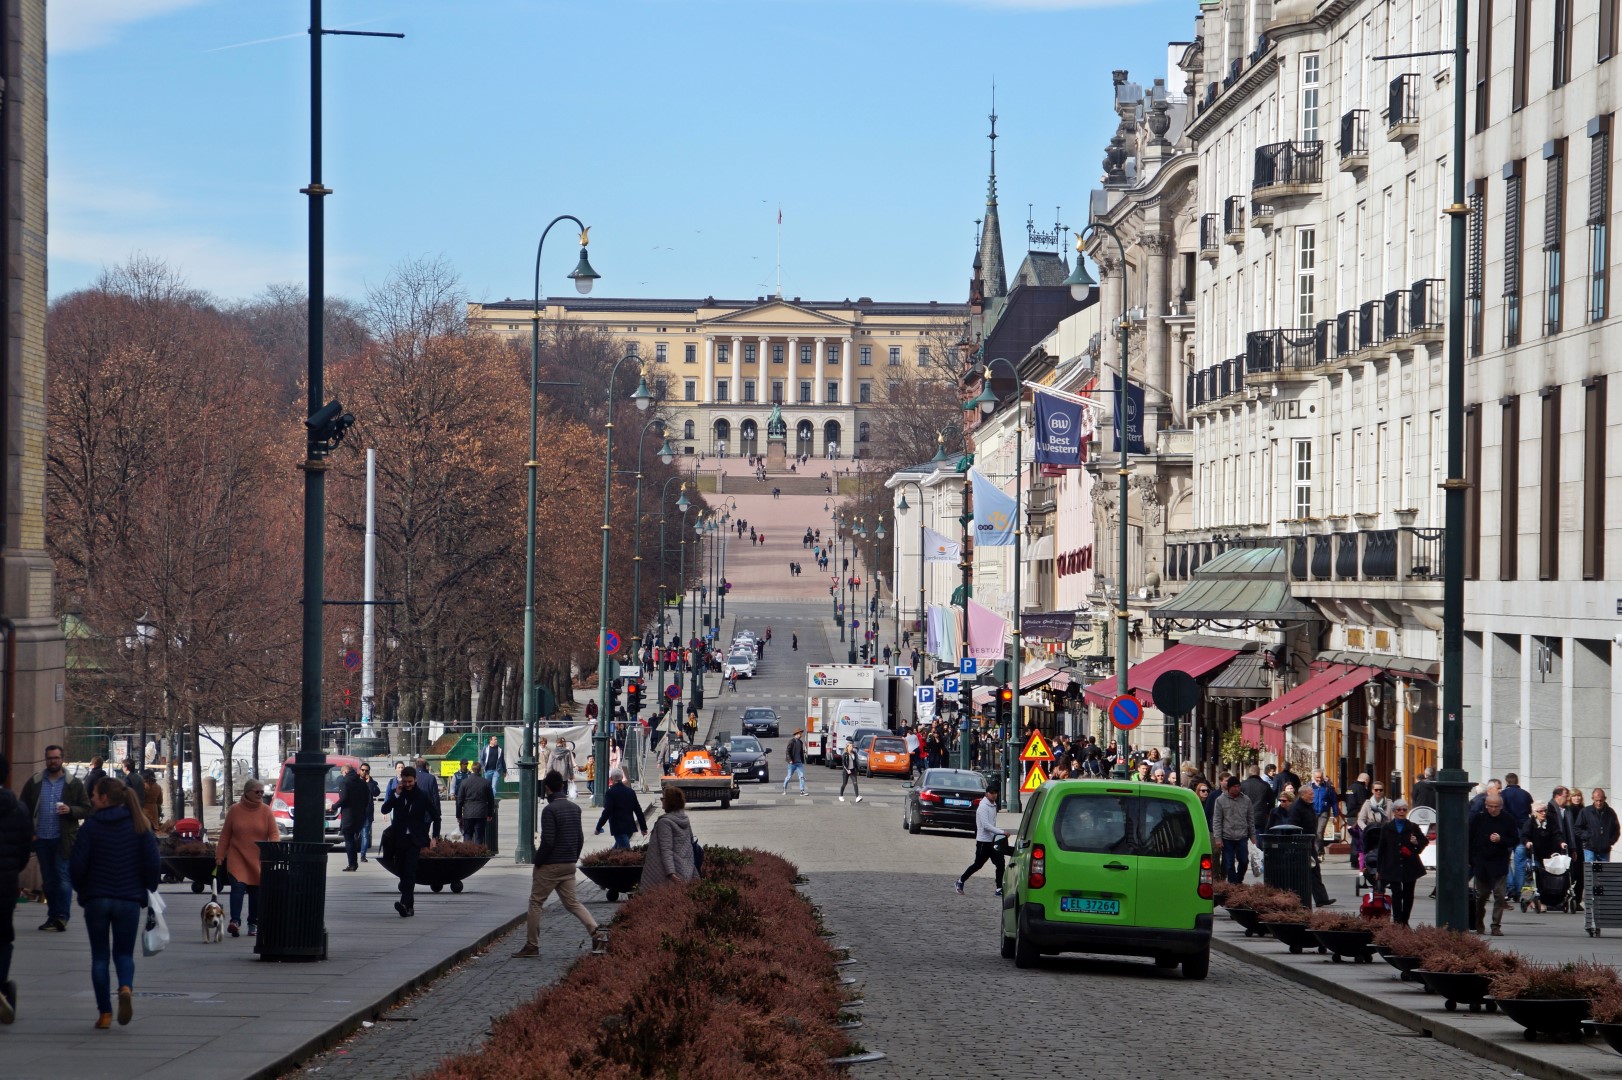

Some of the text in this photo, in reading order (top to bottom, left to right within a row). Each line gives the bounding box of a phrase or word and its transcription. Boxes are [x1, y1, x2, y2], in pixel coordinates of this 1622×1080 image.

[1272, 400, 1307, 420] HOTEL
[1051, 419, 1069, 428] BW
[1049, 435, 1070, 445] Best
[1037, 442, 1078, 454] Western
[964, 659, 973, 672] P
[821, 678, 839, 686] NEP
[946, 680, 955, 692] P
[922, 689, 931, 701] P
[1070, 899, 1115, 911] EL 37264
